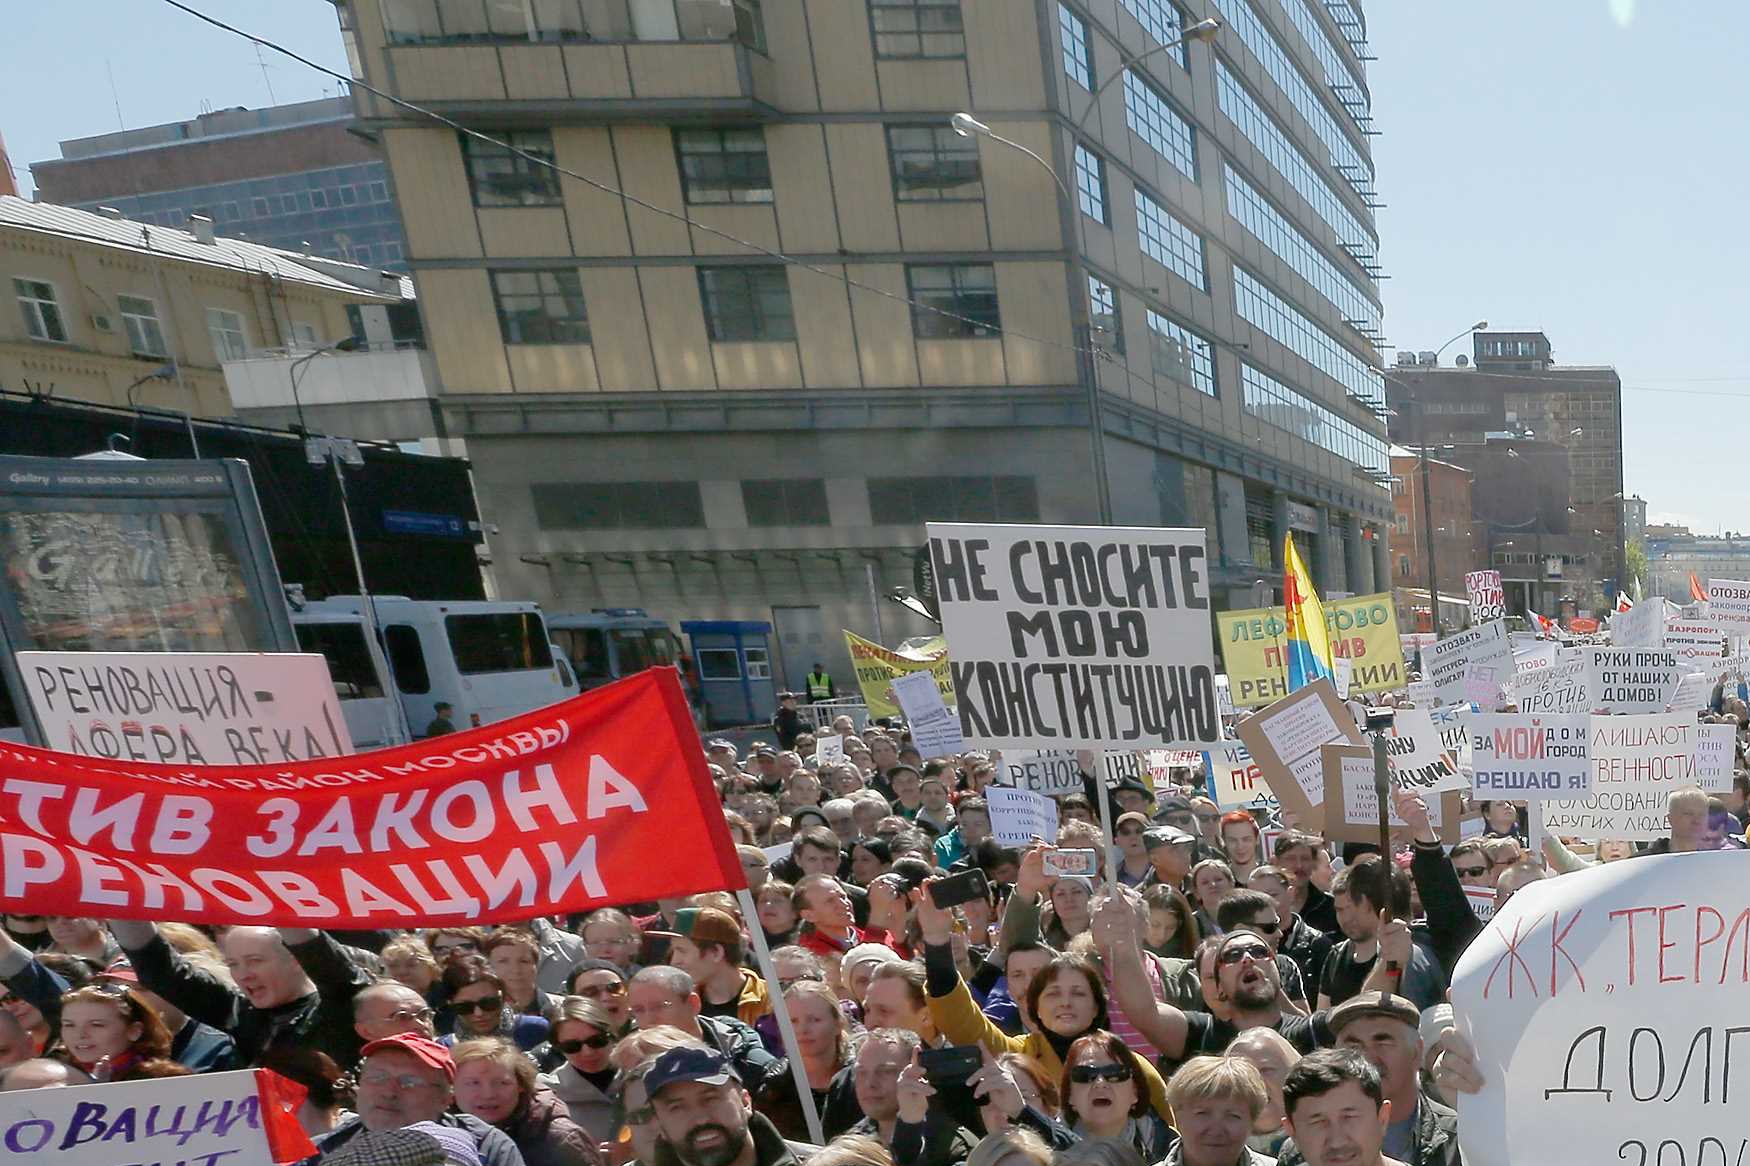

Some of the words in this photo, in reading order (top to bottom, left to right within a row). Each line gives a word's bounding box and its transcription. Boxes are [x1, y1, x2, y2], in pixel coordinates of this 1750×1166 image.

[930, 538, 998, 601] НЕ
[1009, 540, 1209, 608] СНОСИТЕ
[1006, 609, 1150, 659] МОЮ
[1264, 637, 1367, 668] ПИВ
[1436, 632, 1481, 654] ОТОЗВАТЬ
[1431, 657, 1469, 677] ИНТЕРЕСЫ
[1594, 652, 1631, 667] РУКИ
[1636, 652, 1677, 667] ПРОЧЬ
[1602, 672, 1619, 683] ОТ
[1623, 672, 1671, 684] НАШИХ
[34, 665, 253, 722] РЕНОВАЦИЯ
[1240, 662, 1398, 700] РЕНЦИИ
[1522, 685, 1586, 713] ПРОТИВ
[1601, 687, 1662, 703] ДОМОВ!
[951, 660, 1220, 744] КОНСТИТУЦИЮ
[67, 719, 209, 765] АФЕРА
[223, 701, 346, 766] ВЕКА!
[1474, 735, 1494, 750] ЗА
[1494, 719, 1545, 760] МОЙ
[1546, 728, 1586, 741] ДОМ
[1546, 746, 1587, 759] ГОРОД
[1592, 725, 1691, 748] ЛИШАЮТ
[224, 765, 388, 794] РАЙОН
[388, 719, 571, 779] МОСКВЫ
[1476, 771, 1562, 789] РЕШАЮ
[1568, 771, 1587, 789] я!
[0, 778, 214, 856] ТИВ
[246, 754, 649, 859] ЗАКОНА
[1546, 814, 1614, 829] ДРУГИХ
[2, 835, 609, 920] РЕНОВАЦИИ
[1482, 906, 1587, 1000] ЖК
[4, 1093, 261, 1154] ОВАЦИЯ
